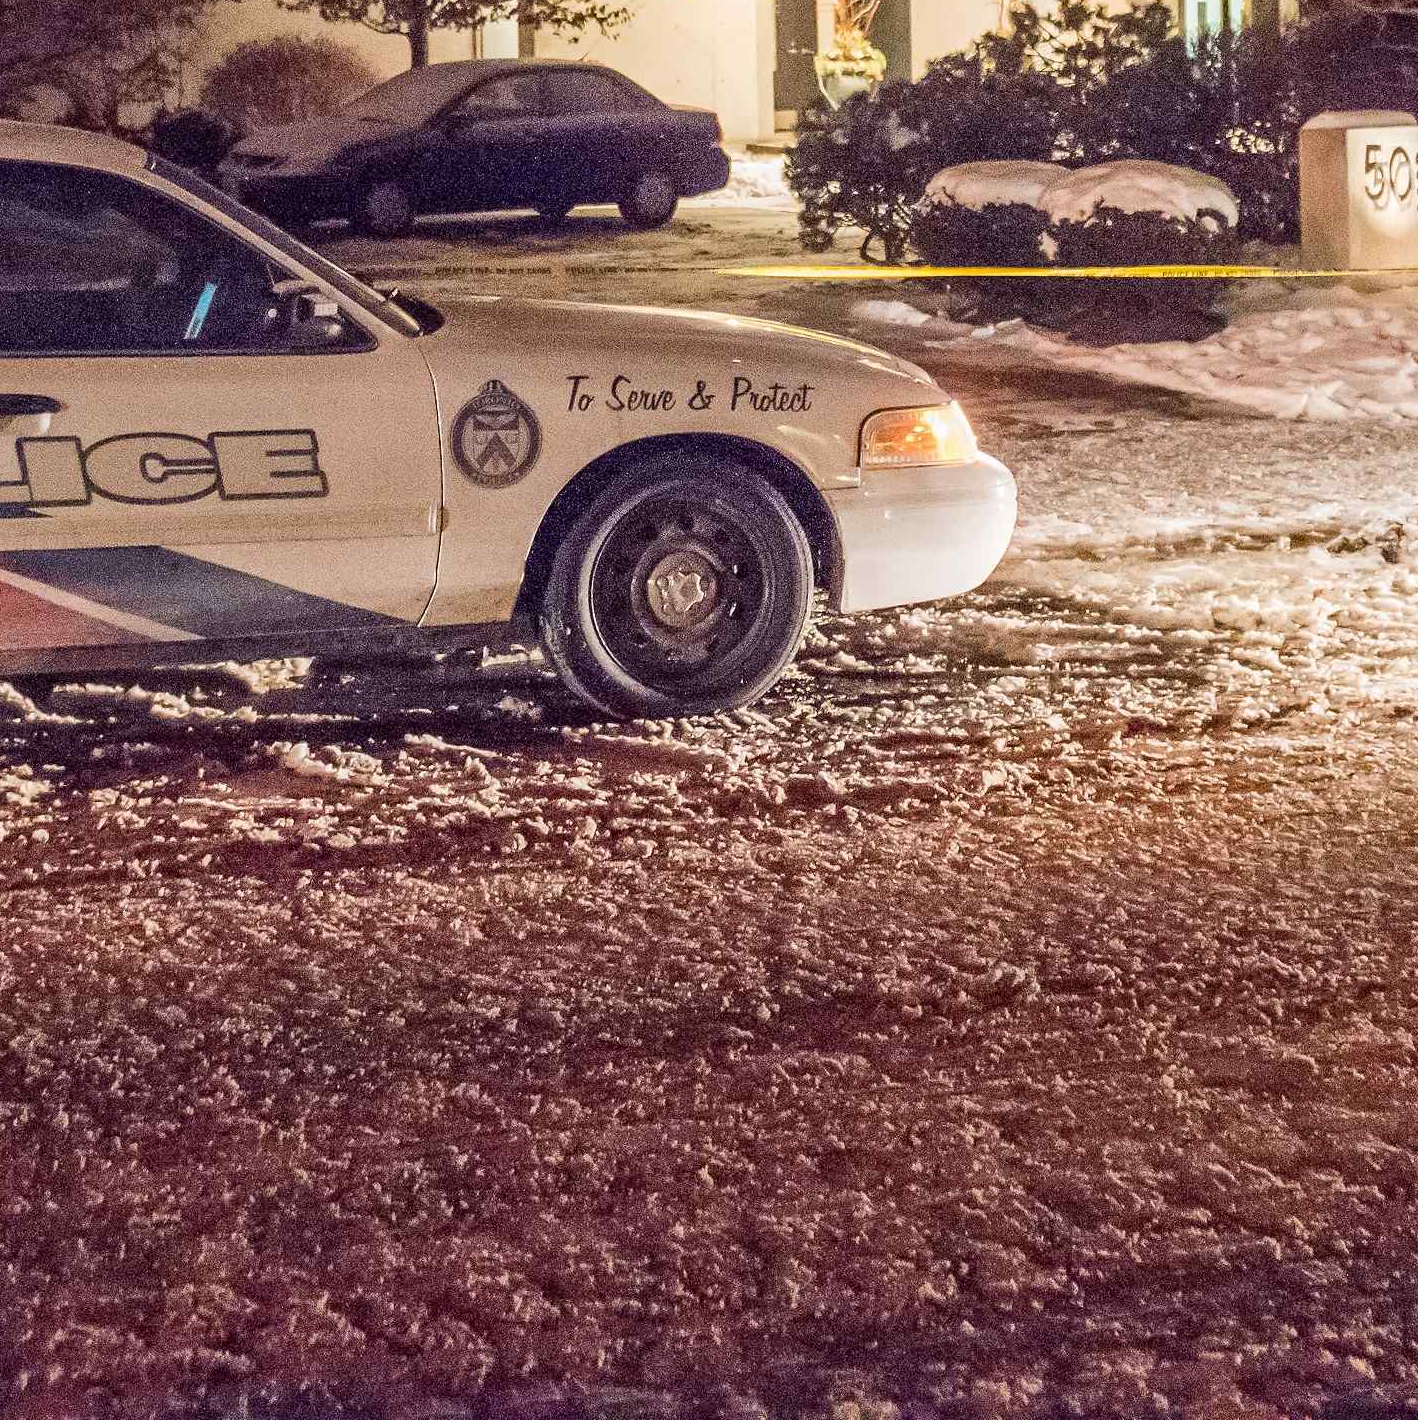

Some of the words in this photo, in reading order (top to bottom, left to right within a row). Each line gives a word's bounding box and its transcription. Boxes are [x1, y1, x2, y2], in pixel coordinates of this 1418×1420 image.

[565, 374, 595, 412] To
[605, 373, 677, 412] Serve
[687, 379, 715, 411] &
[730, 375, 816, 413] Protect
